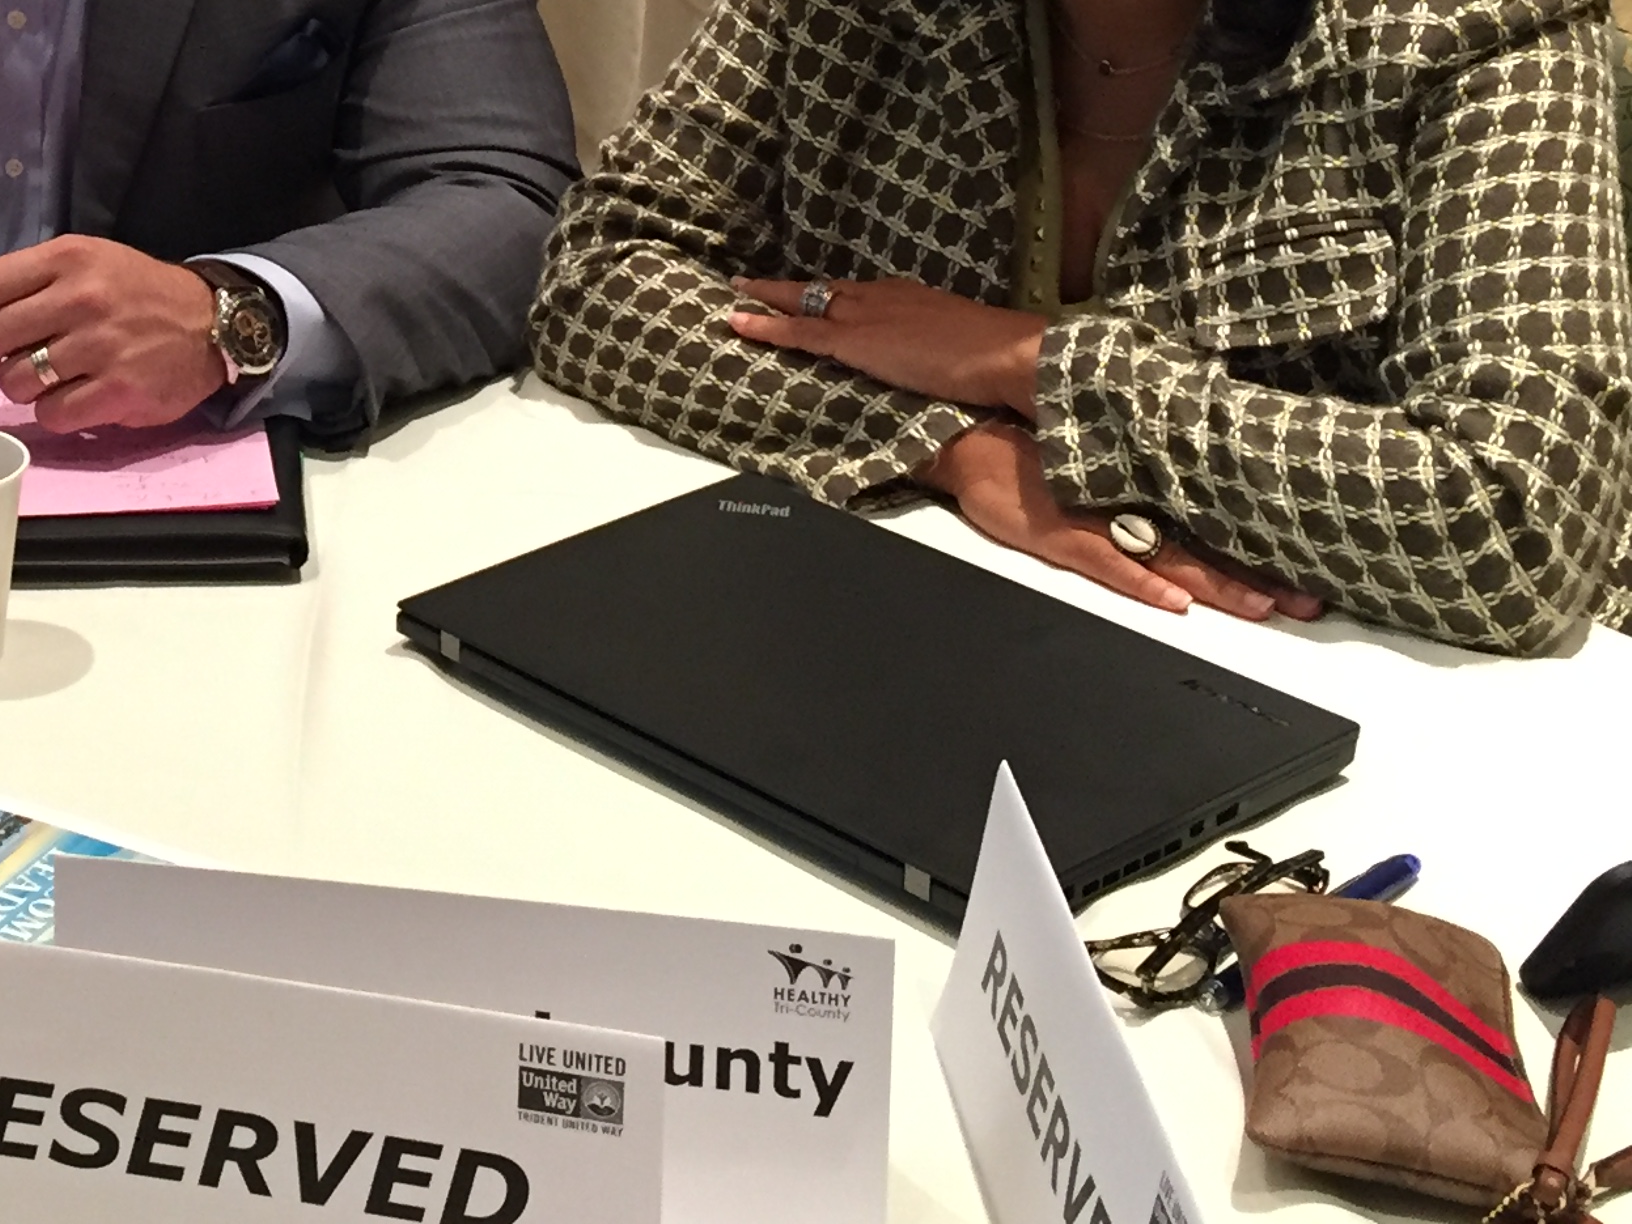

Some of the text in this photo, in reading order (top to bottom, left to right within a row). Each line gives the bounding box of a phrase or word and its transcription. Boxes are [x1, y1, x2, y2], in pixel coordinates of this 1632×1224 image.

[718, 498, 791, 518] ThinkPad
[773, 987, 852, 1008] HEALTHY
[773, 1002, 851, 1023] Tri-County
[518, 1042, 627, 1077] LIVE UNITED
[521, 1070, 579, 1095] United
[981, 929, 1113, 1224] RESERV
[542, 1091, 578, 1115] Way
[518, 1110, 560, 1129] TRIDENT
